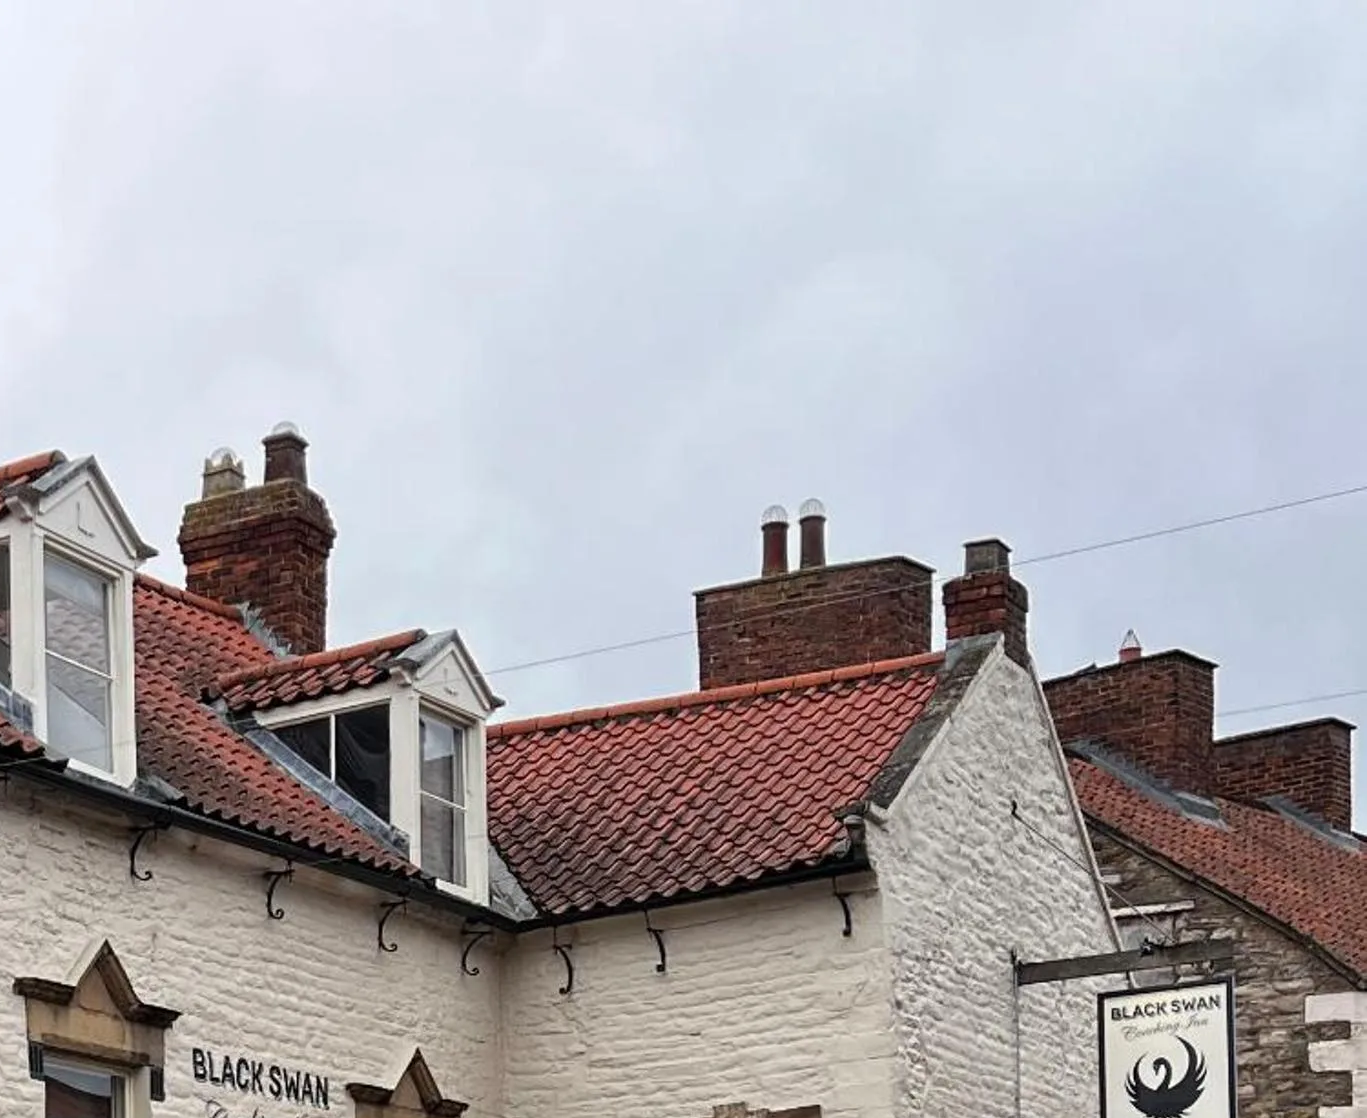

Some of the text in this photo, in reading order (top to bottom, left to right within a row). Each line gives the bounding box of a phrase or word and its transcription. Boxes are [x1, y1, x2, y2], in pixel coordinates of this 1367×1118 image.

[1111, 995, 1221, 1021] BLACK SWAN
[192, 1048, 329, 1110] BLACK SWAN
